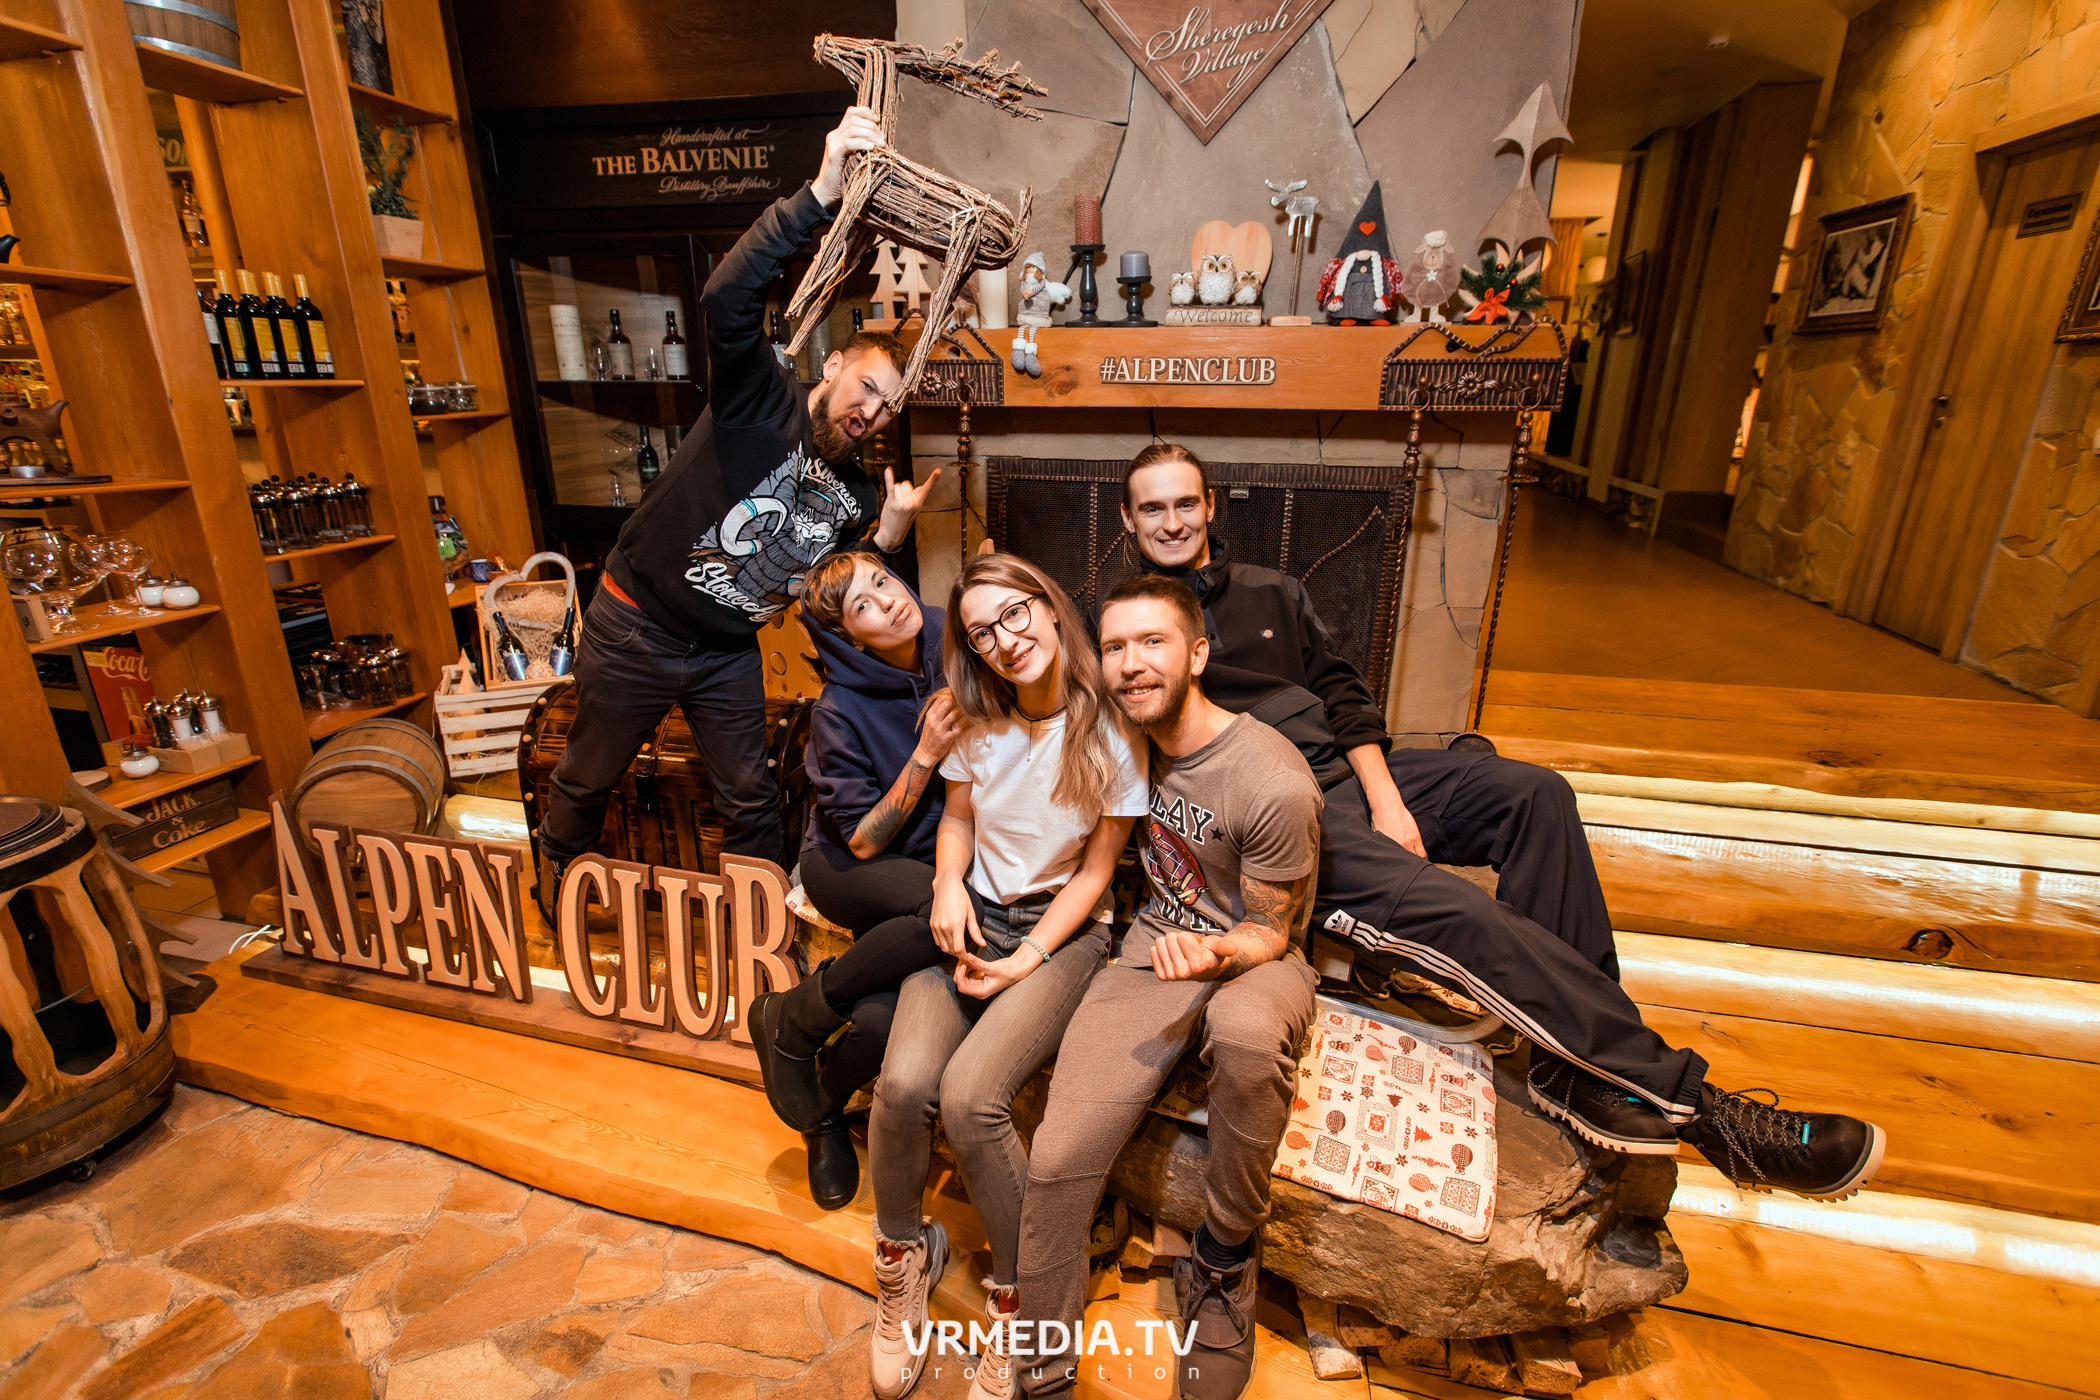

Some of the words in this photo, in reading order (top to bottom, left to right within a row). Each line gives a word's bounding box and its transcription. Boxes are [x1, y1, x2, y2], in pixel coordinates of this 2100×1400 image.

[1144, 0, 1293, 69] Sheregesh
[1179, 41, 1266, 89] Village
[660, 126, 735, 147] Handcrafted
[592, 155, 637, 176] THE
[1174, 308, 1253, 324] Welcome
[1100, 357, 1276, 383] #ALPENCLUB
[171, 815, 184, 826] &
[1149, 776, 1215, 846] LAY
[270, 796, 527, 1002] ALPEN
[559, 858, 800, 1044] CLUB
